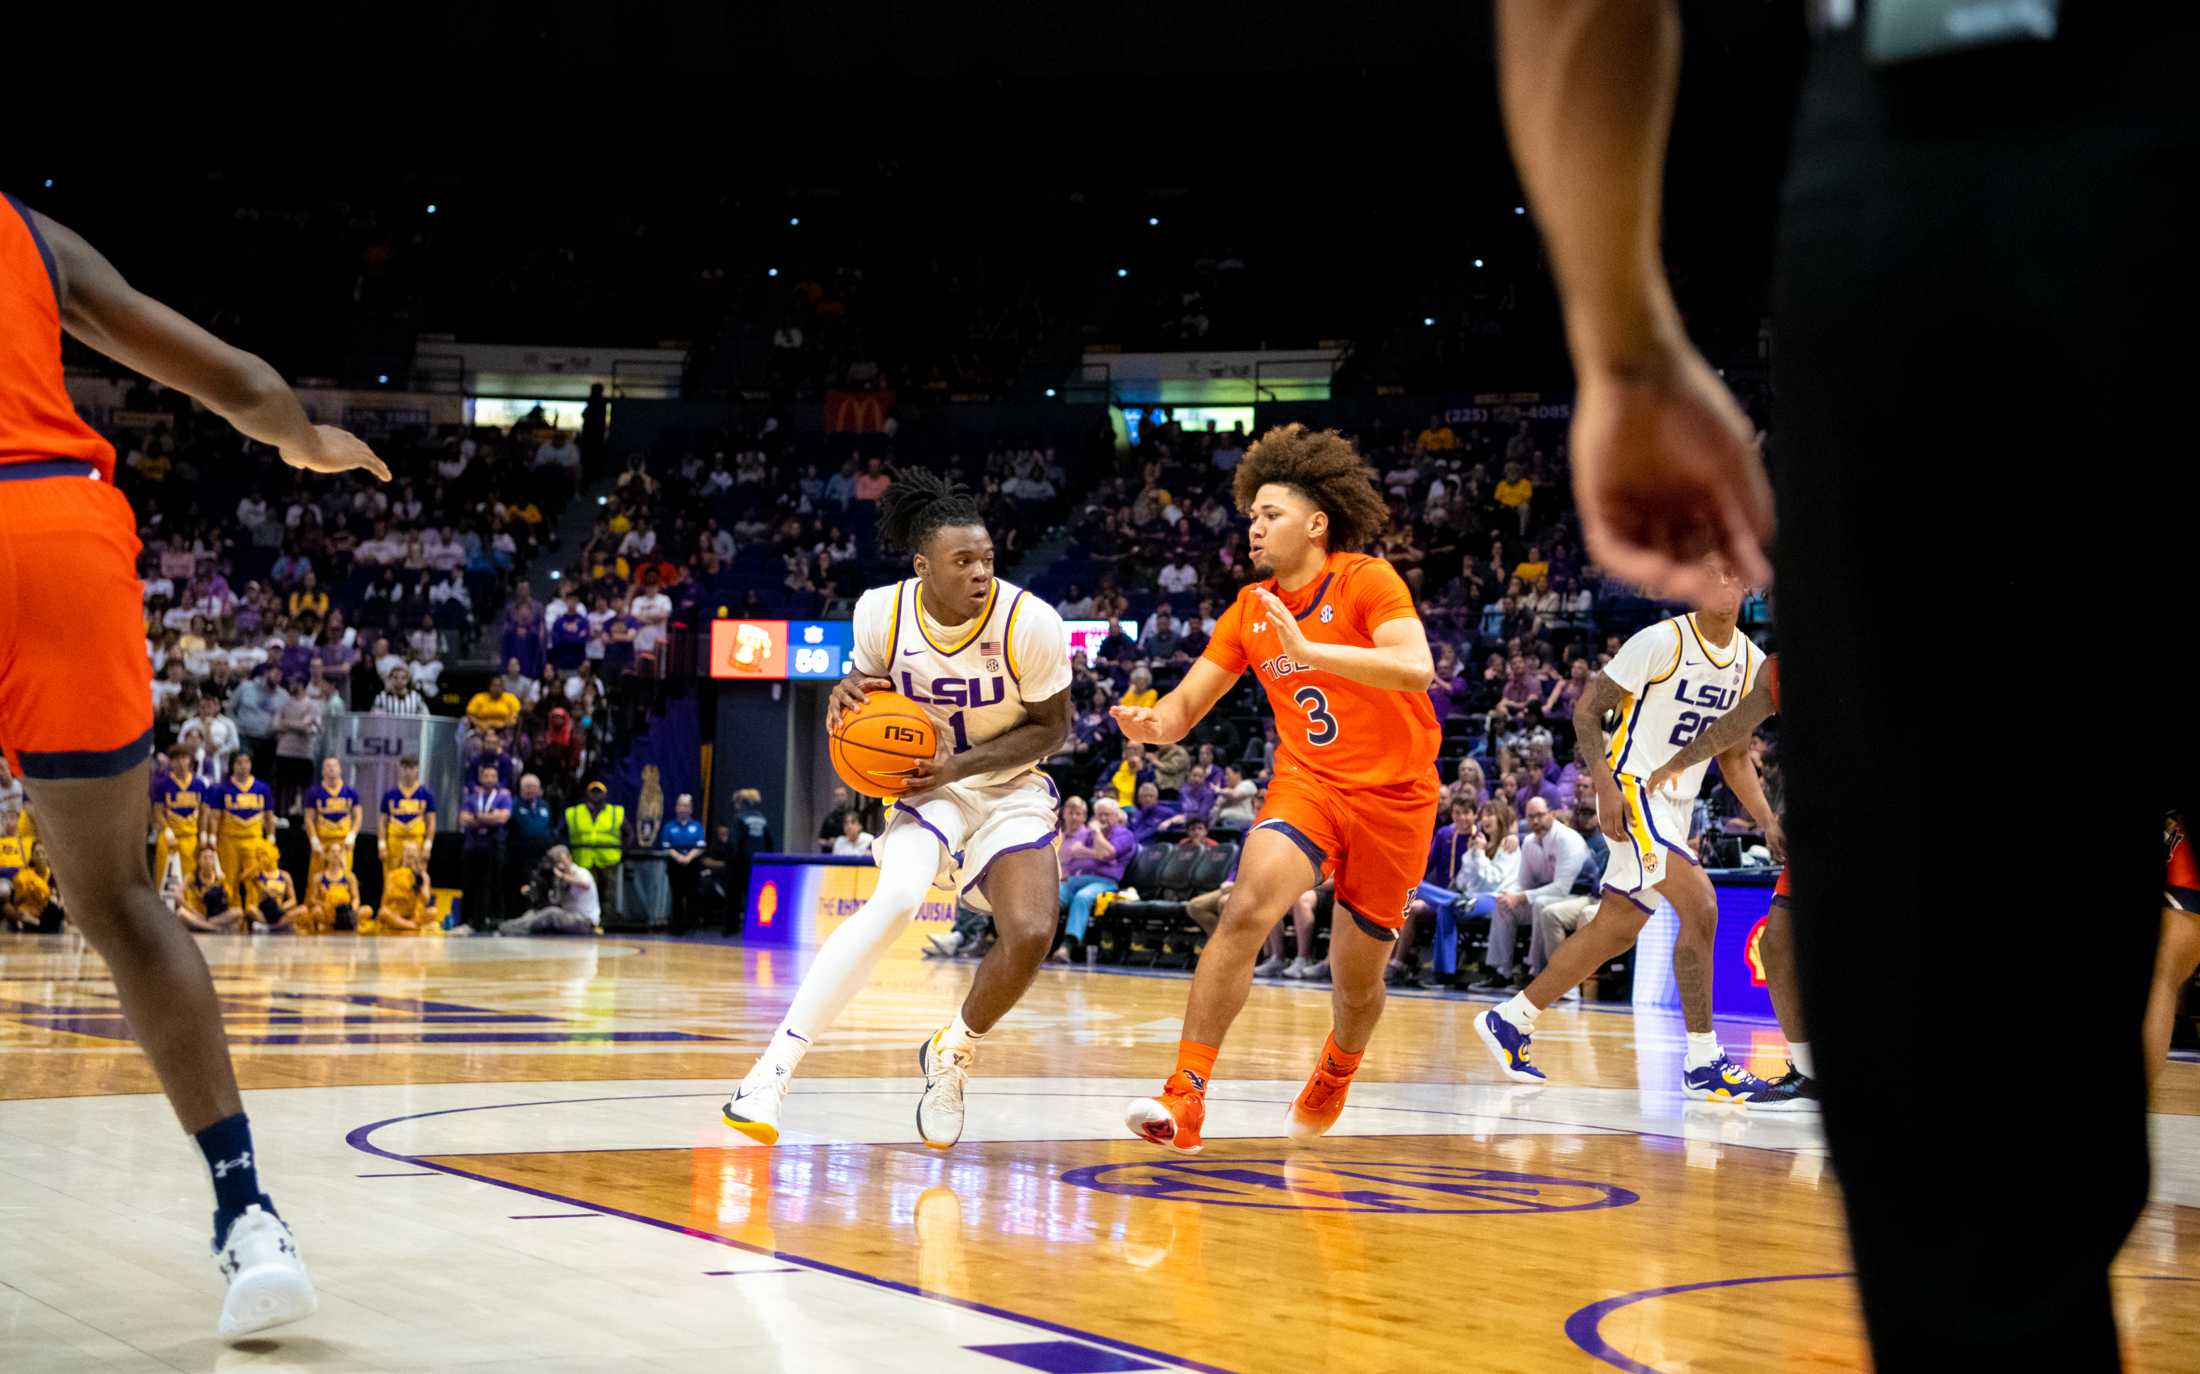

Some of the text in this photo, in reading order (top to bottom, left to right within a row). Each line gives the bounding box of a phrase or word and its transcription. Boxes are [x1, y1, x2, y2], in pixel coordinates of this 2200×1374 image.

[901, 671, 1005, 709] LSU
[1673, 678, 1738, 711] LSU
[948, 710, 973, 755] 1
[1293, 685, 1339, 747] 3
[345, 737, 403, 757] LSU
[883, 725, 925, 746] LSU
